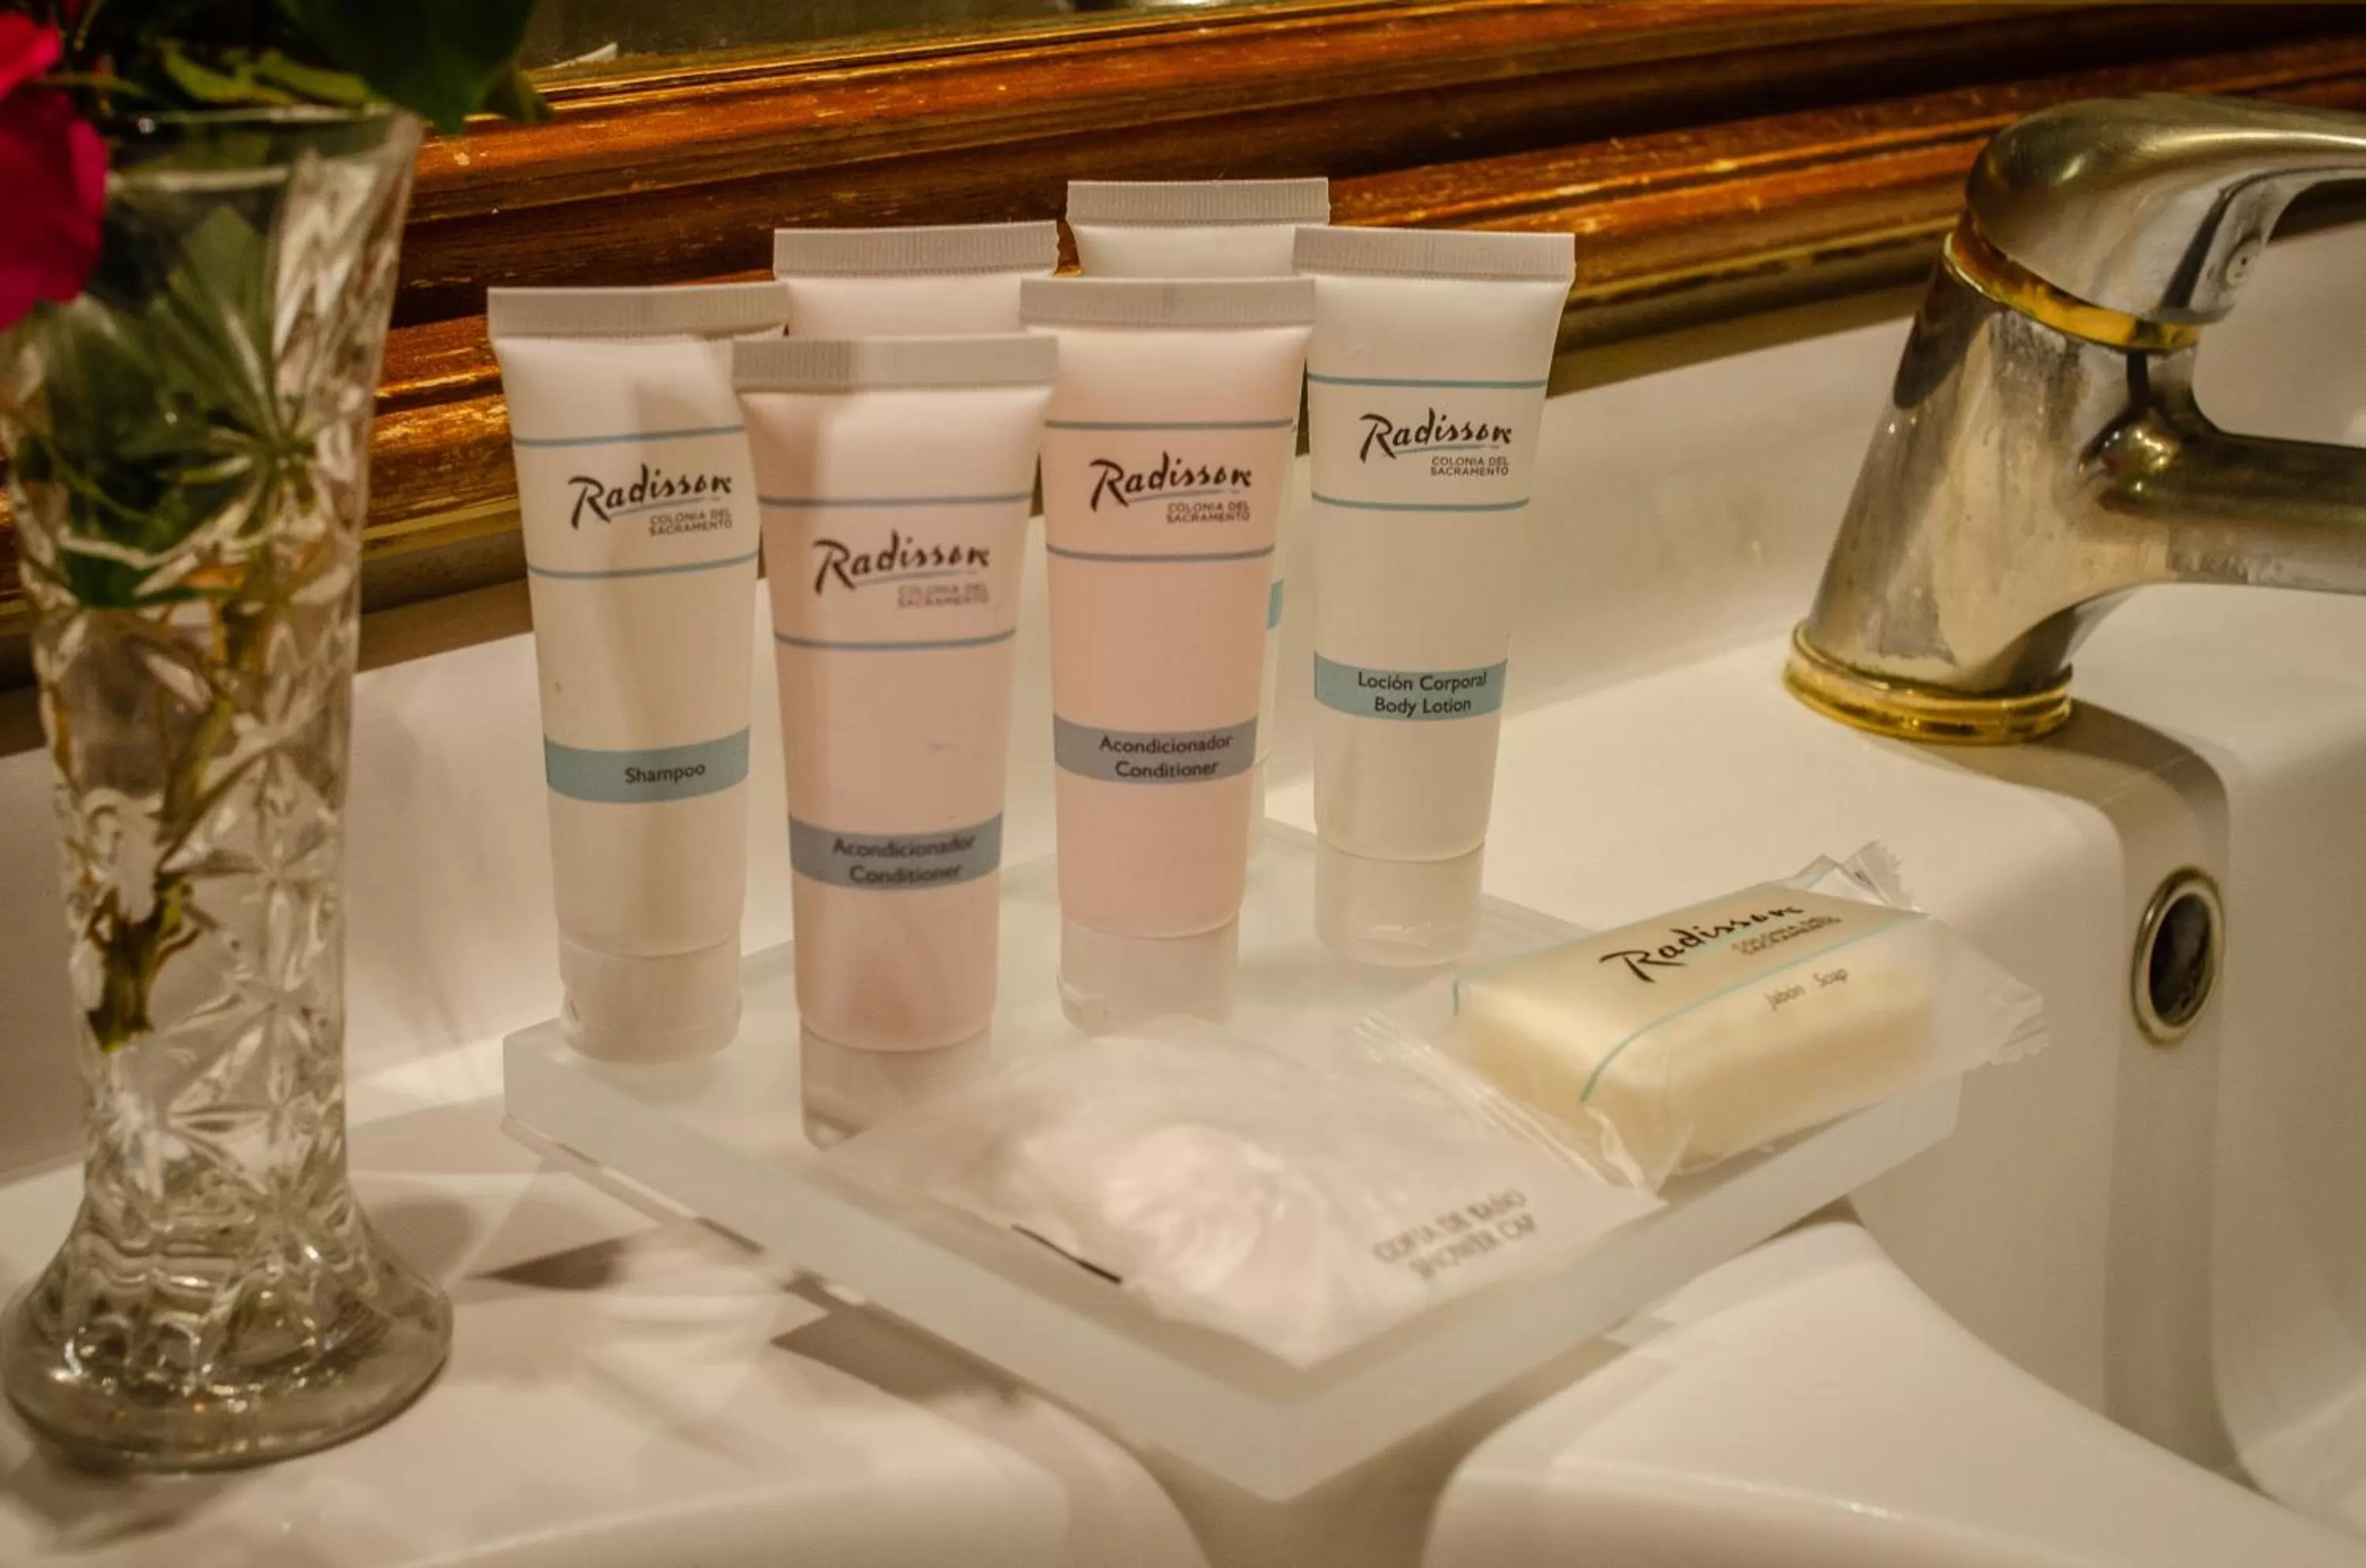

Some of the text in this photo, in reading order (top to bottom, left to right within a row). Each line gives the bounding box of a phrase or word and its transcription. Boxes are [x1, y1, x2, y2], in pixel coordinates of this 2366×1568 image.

[1360, 406, 1512, 464] Radisson
[1430, 466, 1510, 477] SACRAMENTO
[1431, 456, 1509, 467] COLONIA DEL
[1089, 450, 1252, 512] Radisson
[567, 462, 733, 530] Radisson
[1166, 501, 1224, 513] COLONIA
[1166, 511, 1251, 525] SACRAMENTO
[812, 528, 989, 596] Radisson
[1358, 671, 1487, 694] Loción Corporal
[1375, 696, 1472, 718] Body Lotion
[1099, 734, 1234, 754] Acondicionador
[625, 763, 706, 784] Shampoo
[1115, 760, 1221, 778] Conditioner
[832, 835, 976, 859] Acondicionador
[849, 862, 963, 884] Conditioner
[1598, 905, 1804, 984] Radisson
